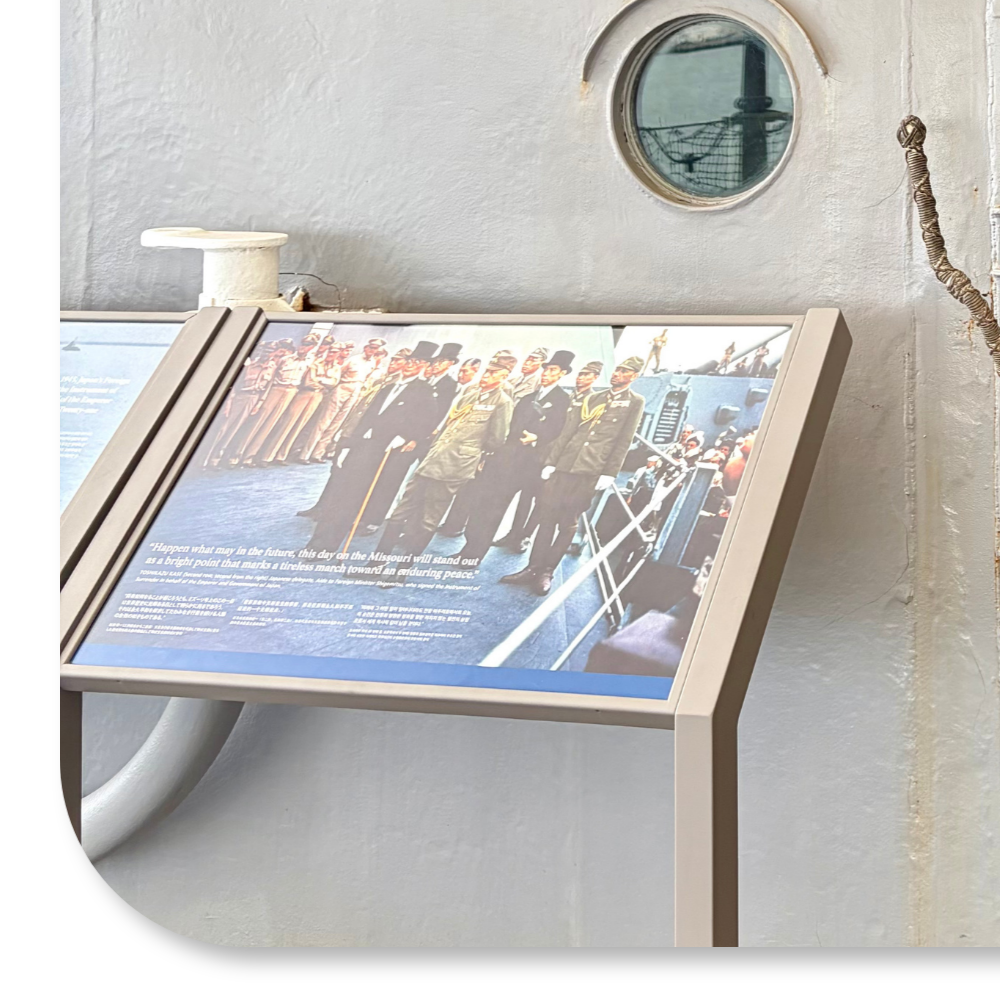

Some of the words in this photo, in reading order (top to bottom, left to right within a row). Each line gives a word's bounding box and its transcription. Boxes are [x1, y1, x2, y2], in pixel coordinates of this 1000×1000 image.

[191, 544, 214, 554] what
[215, 547, 235, 556] may
[236, 546, 245, 555] in
[248, 546, 263, 556] the
[264, 547, 296, 558] future,
[298, 549, 316, 558] this
[317, 550, 335, 561] day
[350, 551, 366, 560] the
[367, 551, 412, 563] Missouri
[413, 554, 432, 564] will
[433, 555, 460, 565] stand
[462, 557, 479, 566] out
[157, 557, 164, 565] a
[164, 556, 194, 568] bright
[193, 558, 221, 568] point
[221, 557, 241, 568] that
[241, 561, 271, 570] marks
[280, 561, 313, 571] tireless
[314, 563, 346, 573] march
[348, 564, 383, 575] toward
[398, 566, 442, 579] enduring
